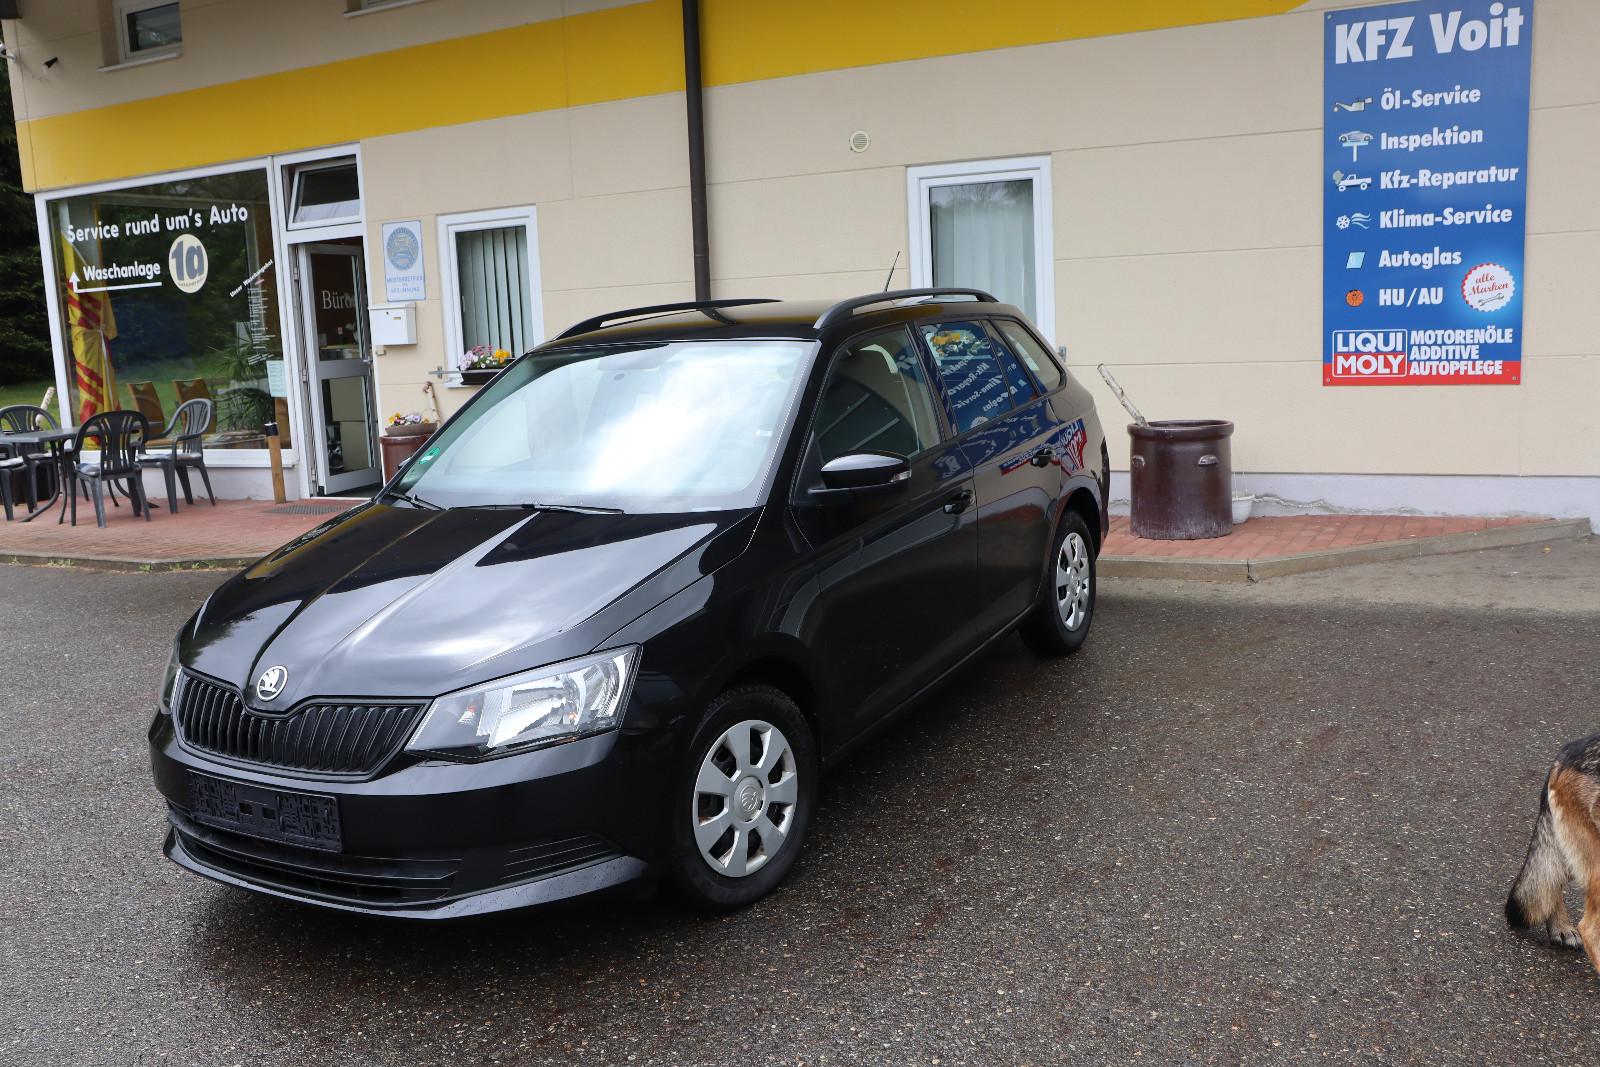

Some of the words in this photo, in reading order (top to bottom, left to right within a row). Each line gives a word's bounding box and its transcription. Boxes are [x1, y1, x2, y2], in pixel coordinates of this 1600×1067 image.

[1335, 16, 1415, 64] KFZ
[1429, 2, 1524, 54] Voit
[1380, 84, 1481, 111] Öl-Service
[1380, 125, 1484, 152] Inspektion
[1380, 165, 1519, 190] Kfz-Reparatur
[67, 221, 119, 243] Service
[125, 213, 160, 236] rund
[165, 207, 203, 231] um's
[209, 203, 248, 226] Auto
[1380, 203, 1513, 229] Klima-Service
[1378, 246, 1462, 270] Autoglas
[83, 261, 161, 280] Waschanlage
[1474, 272, 1495, 284] alle
[1468, 281, 1510, 295] Marken
[1336, 332, 1403, 354] LIQUI
[1410, 325, 1513, 345] MOTORENÖLE
[1410, 345, 1480, 360] ADDITIVE
[1336, 355, 1405, 376] MOLY
[1410, 360, 1503, 376] AUTOPFLEGE
